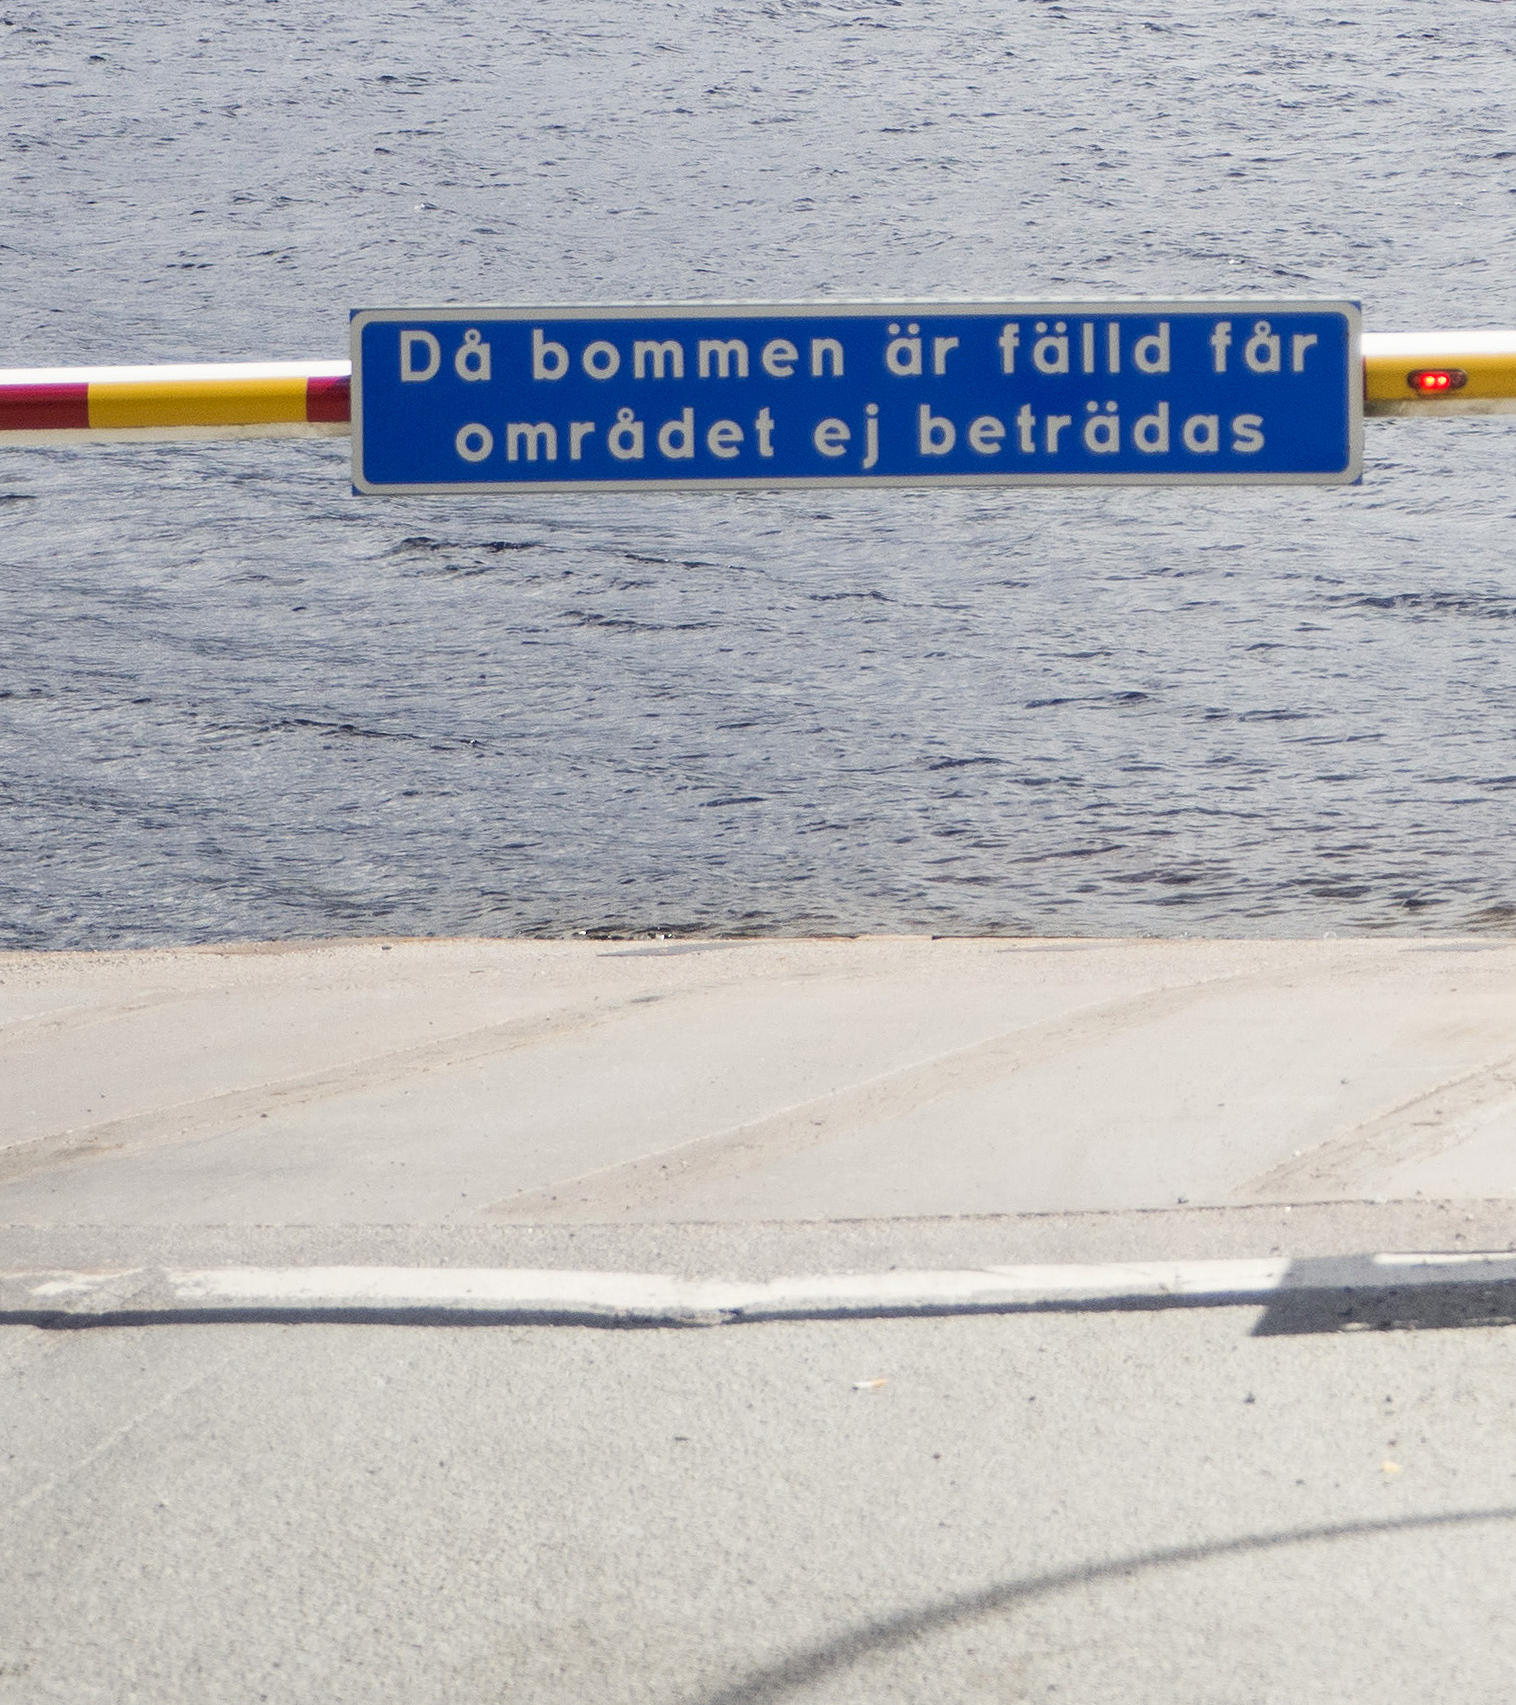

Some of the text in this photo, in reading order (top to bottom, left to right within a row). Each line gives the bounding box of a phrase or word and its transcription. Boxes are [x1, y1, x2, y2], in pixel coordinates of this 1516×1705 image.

[400, 320, 1318, 382] Då bommen är fälld får
[455, 399, 1265, 469] området ej beträdas
